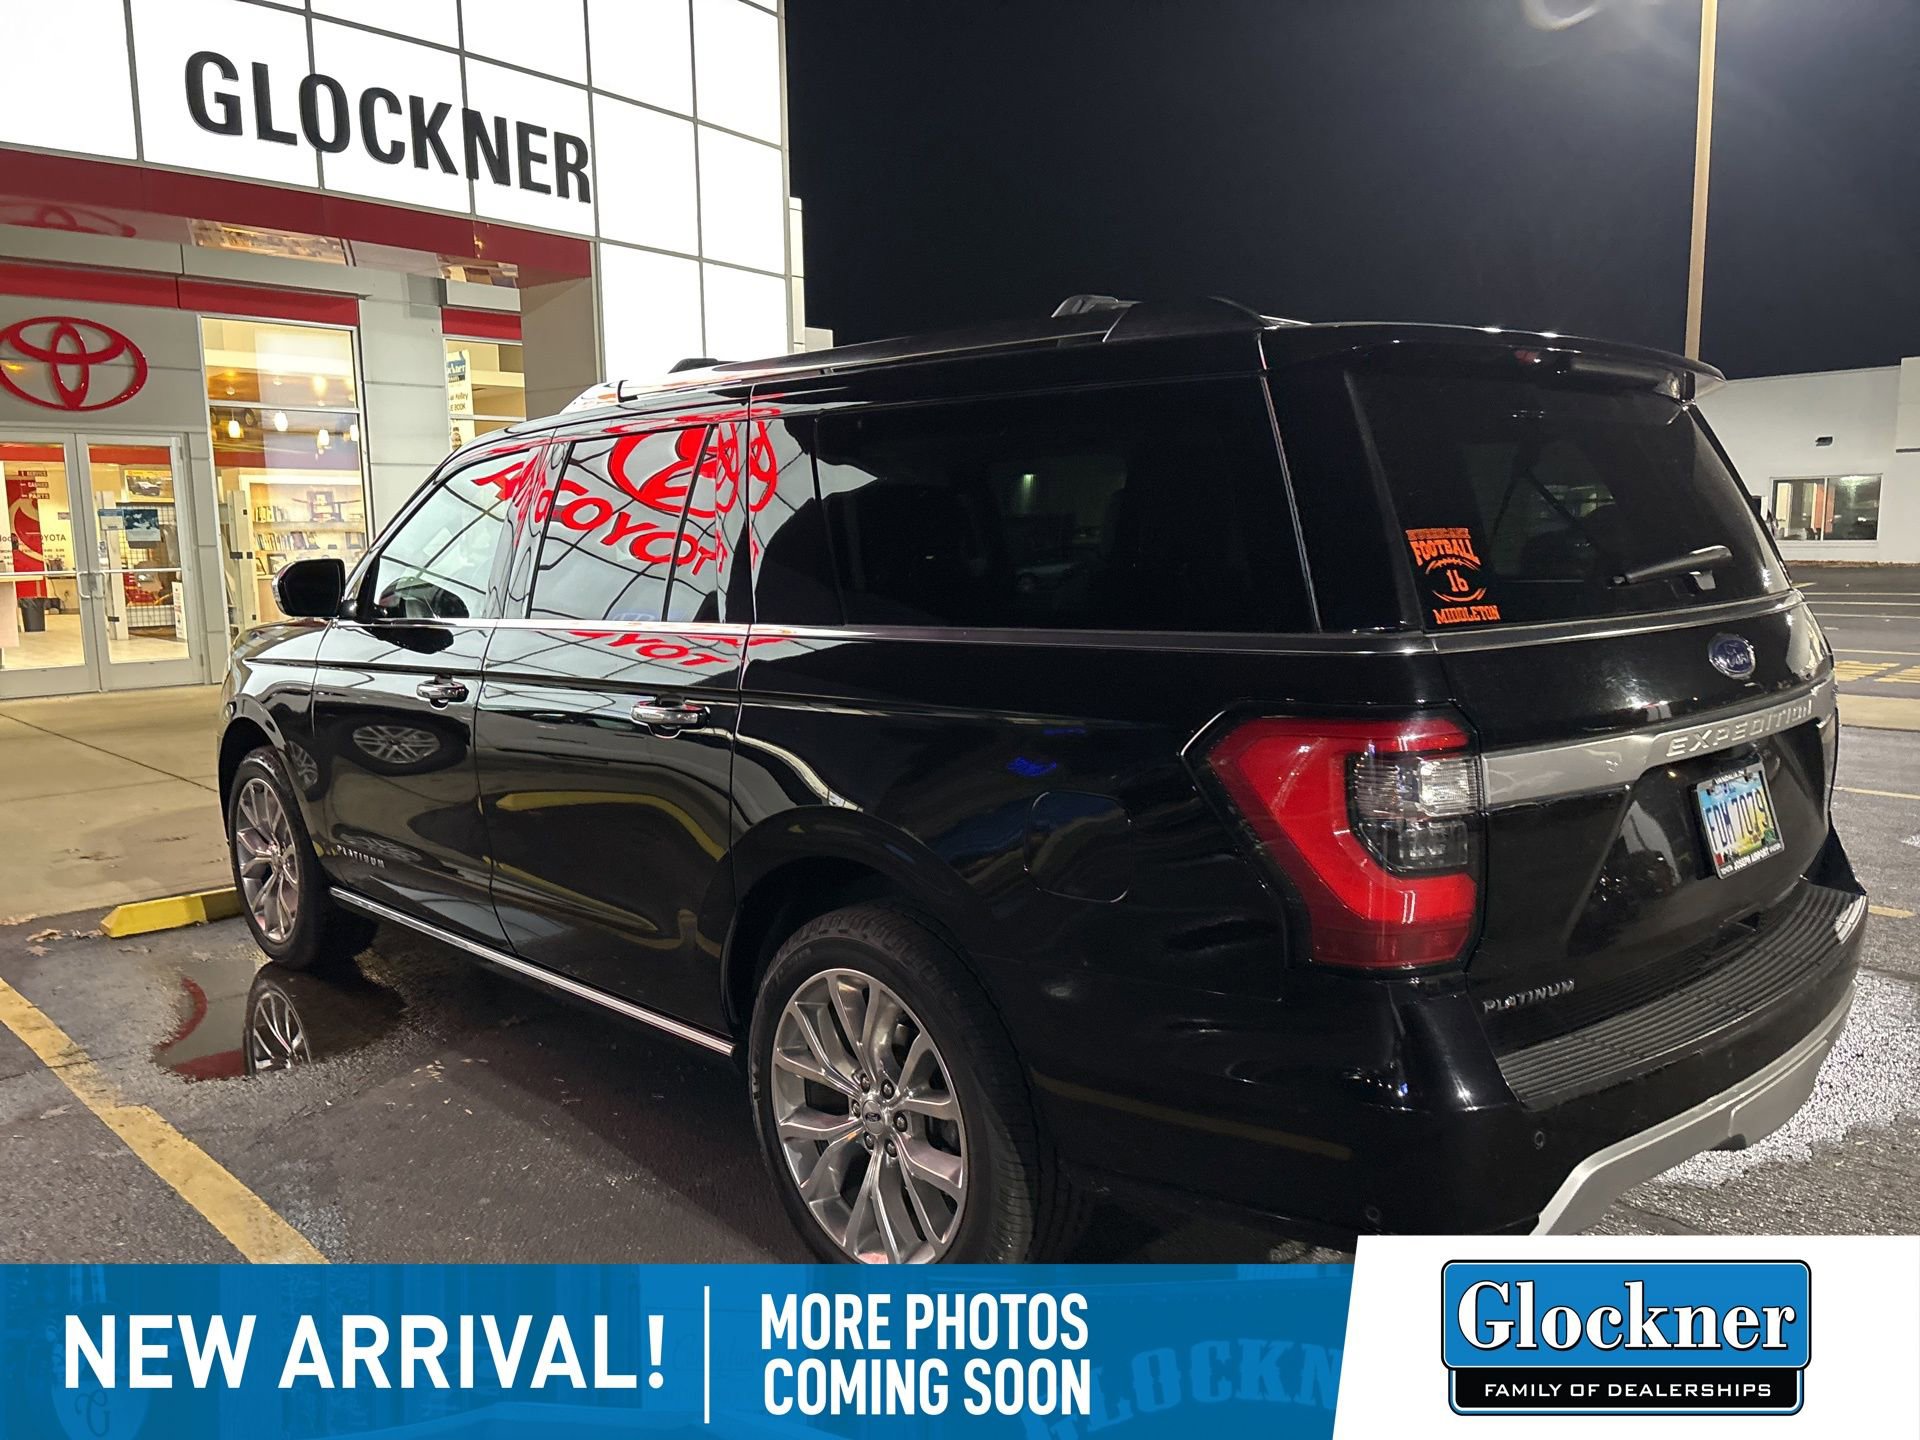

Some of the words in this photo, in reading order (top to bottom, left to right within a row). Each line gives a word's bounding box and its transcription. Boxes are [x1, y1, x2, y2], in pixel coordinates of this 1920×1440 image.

[186, 51, 592, 204] GLOCKNER
[1409, 538, 1481, 567] FOOTBALL
[1446, 569, 1470, 592] 16
[1432, 604, 1502, 625] MIDDLETON
[1666, 699, 1813, 758] EXPEDITION
[336, 844, 386, 869] PLATINUM
[1482, 979, 1575, 1014] PLATINUM
